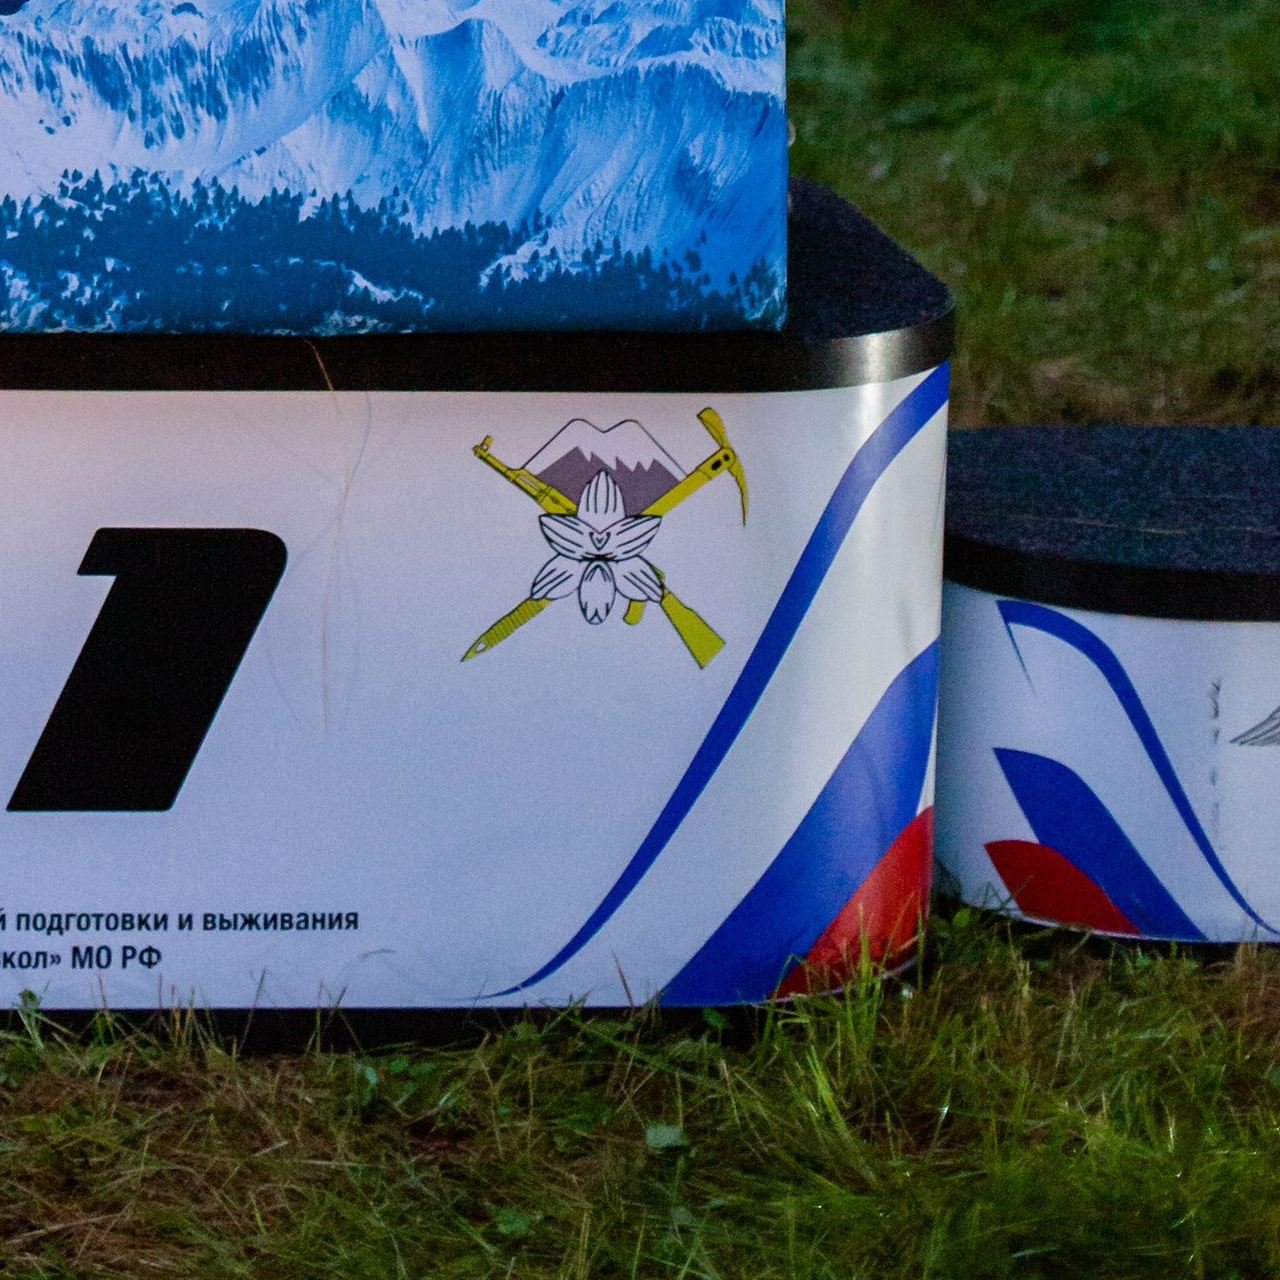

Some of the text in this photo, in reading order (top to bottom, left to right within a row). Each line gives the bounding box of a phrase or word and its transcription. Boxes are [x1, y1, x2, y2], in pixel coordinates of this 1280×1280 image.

[16, 911, 169, 936] подготовки
[179, 913, 193, 931] и
[203, 911, 359, 932] выживания
[71, 944, 113, 970] МО
[121, 944, 162, 970] РФ
